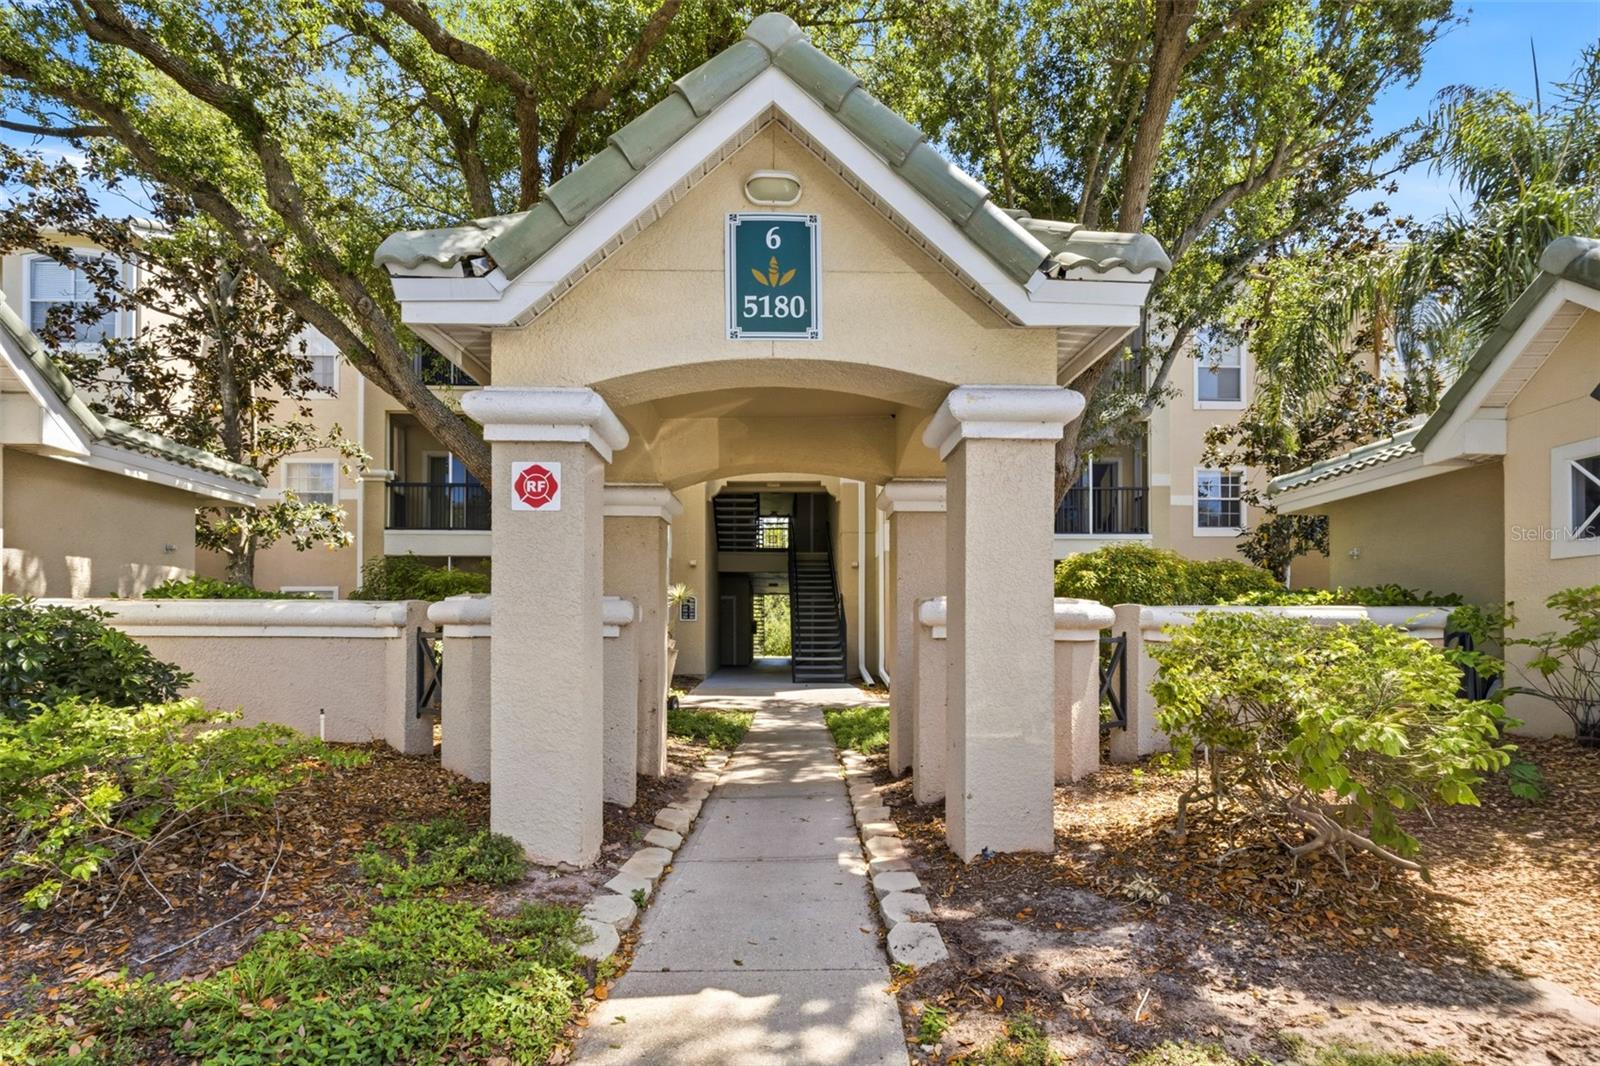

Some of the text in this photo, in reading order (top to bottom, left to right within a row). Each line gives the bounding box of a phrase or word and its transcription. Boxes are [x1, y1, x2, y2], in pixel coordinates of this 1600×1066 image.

[766, 226, 781, 249] 6
[743, 295, 805, 318] 5180
[527, 480, 546, 492] RF
